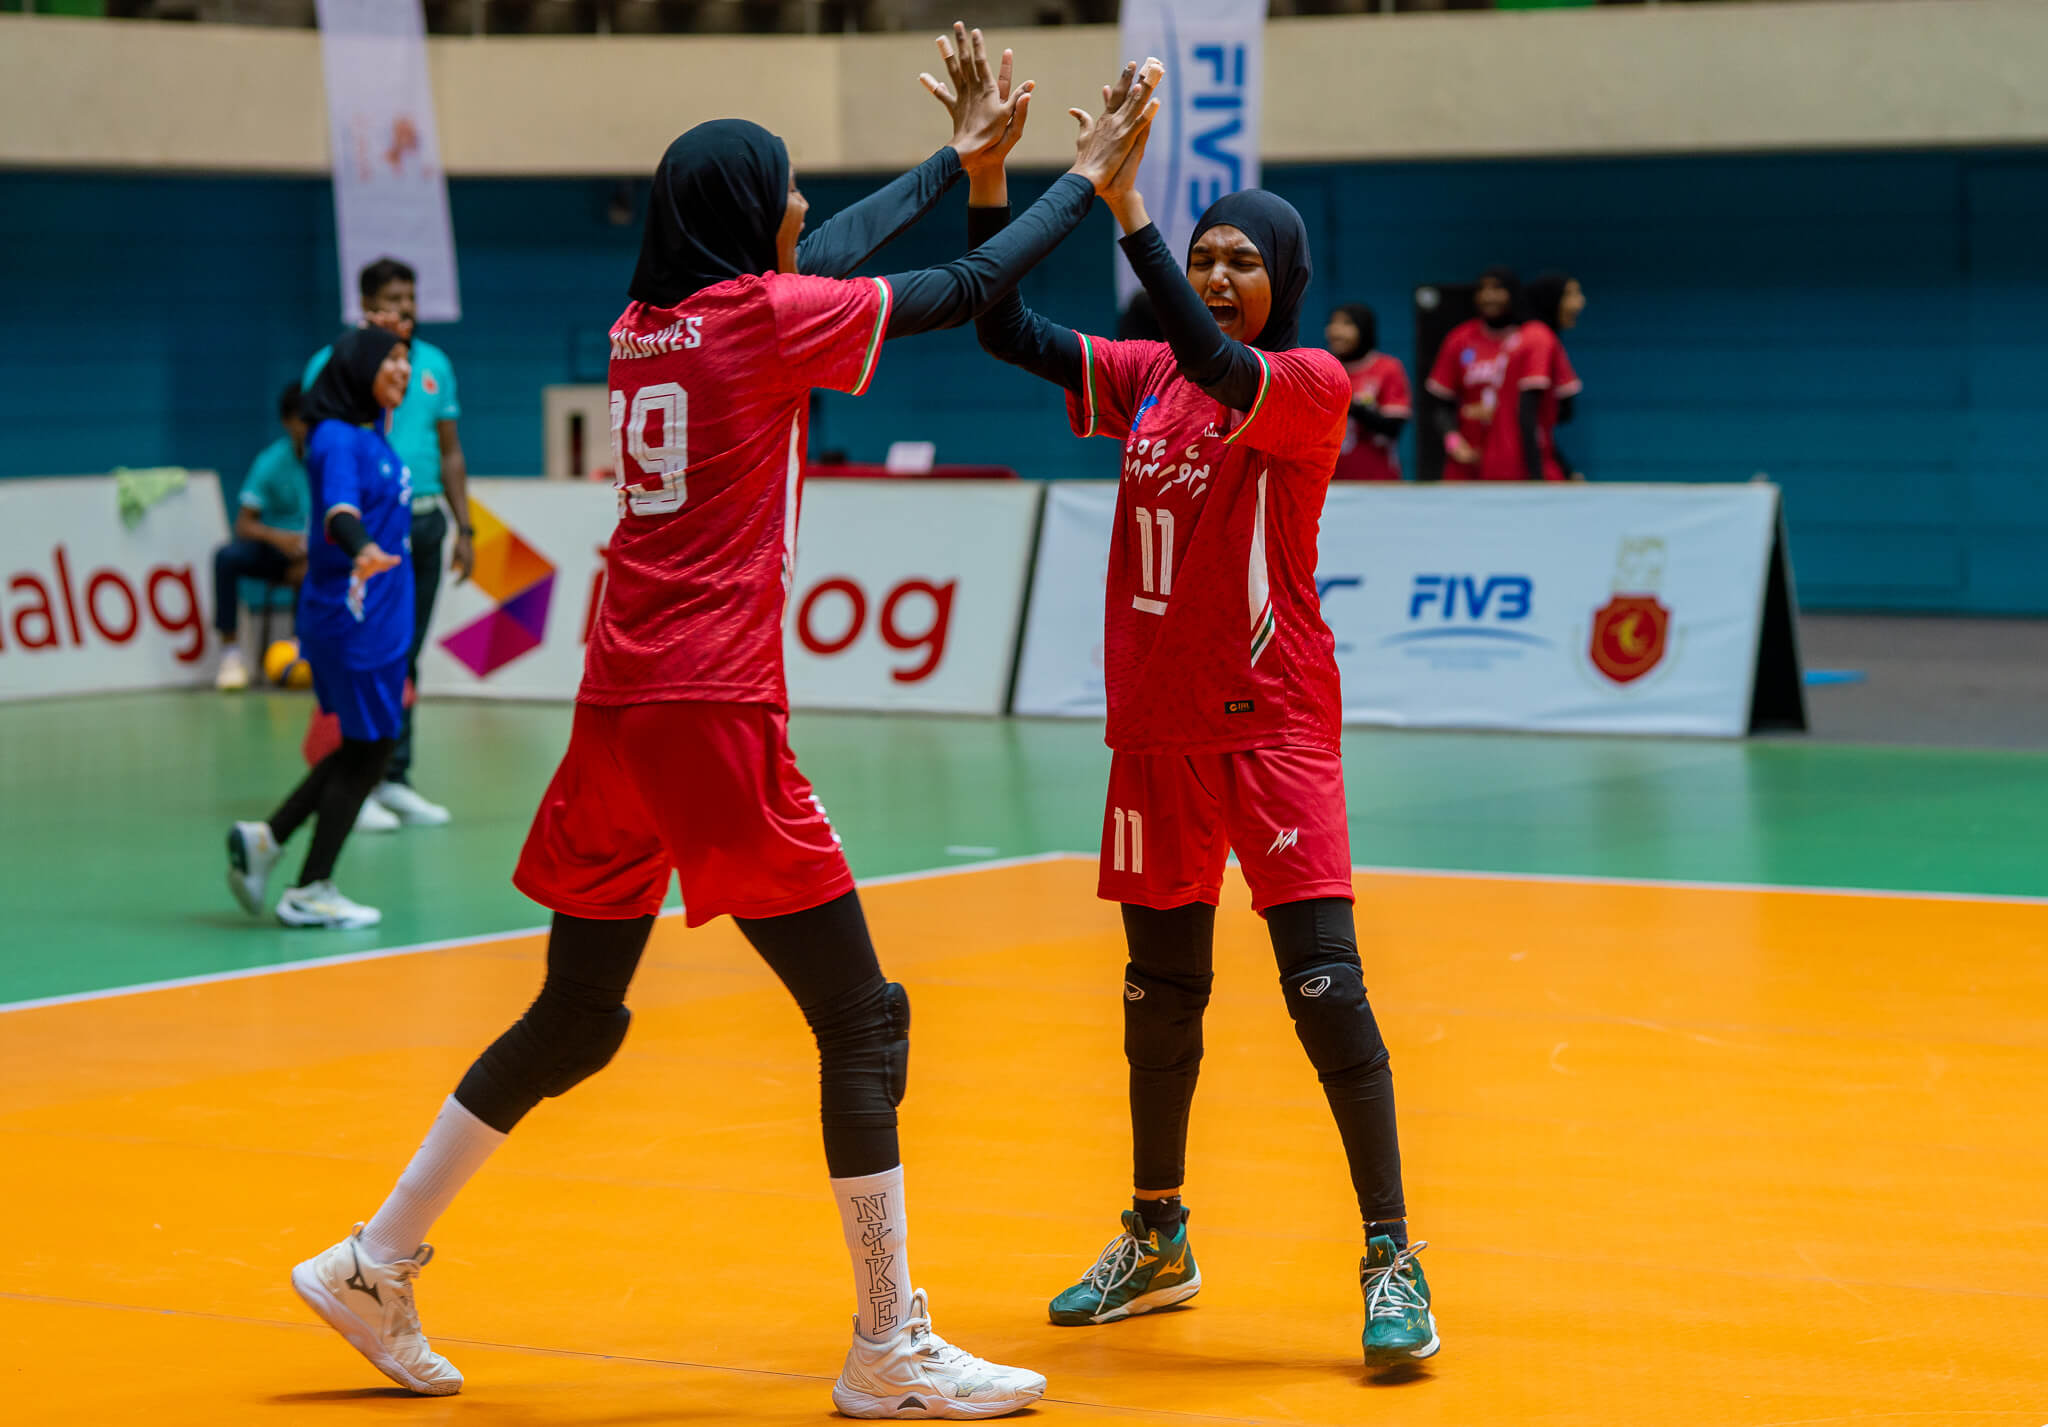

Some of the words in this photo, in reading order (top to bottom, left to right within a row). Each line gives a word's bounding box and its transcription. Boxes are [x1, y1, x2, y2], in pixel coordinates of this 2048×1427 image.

[610, 316, 704, 360] MALDIVES
[1135, 506, 1175, 596] 11
[0, 546, 206, 663] alog
[1409, 574, 1534, 621] FIVB
[1113, 806, 1143, 874] 11
[851, 1192, 898, 1336] NIKE
